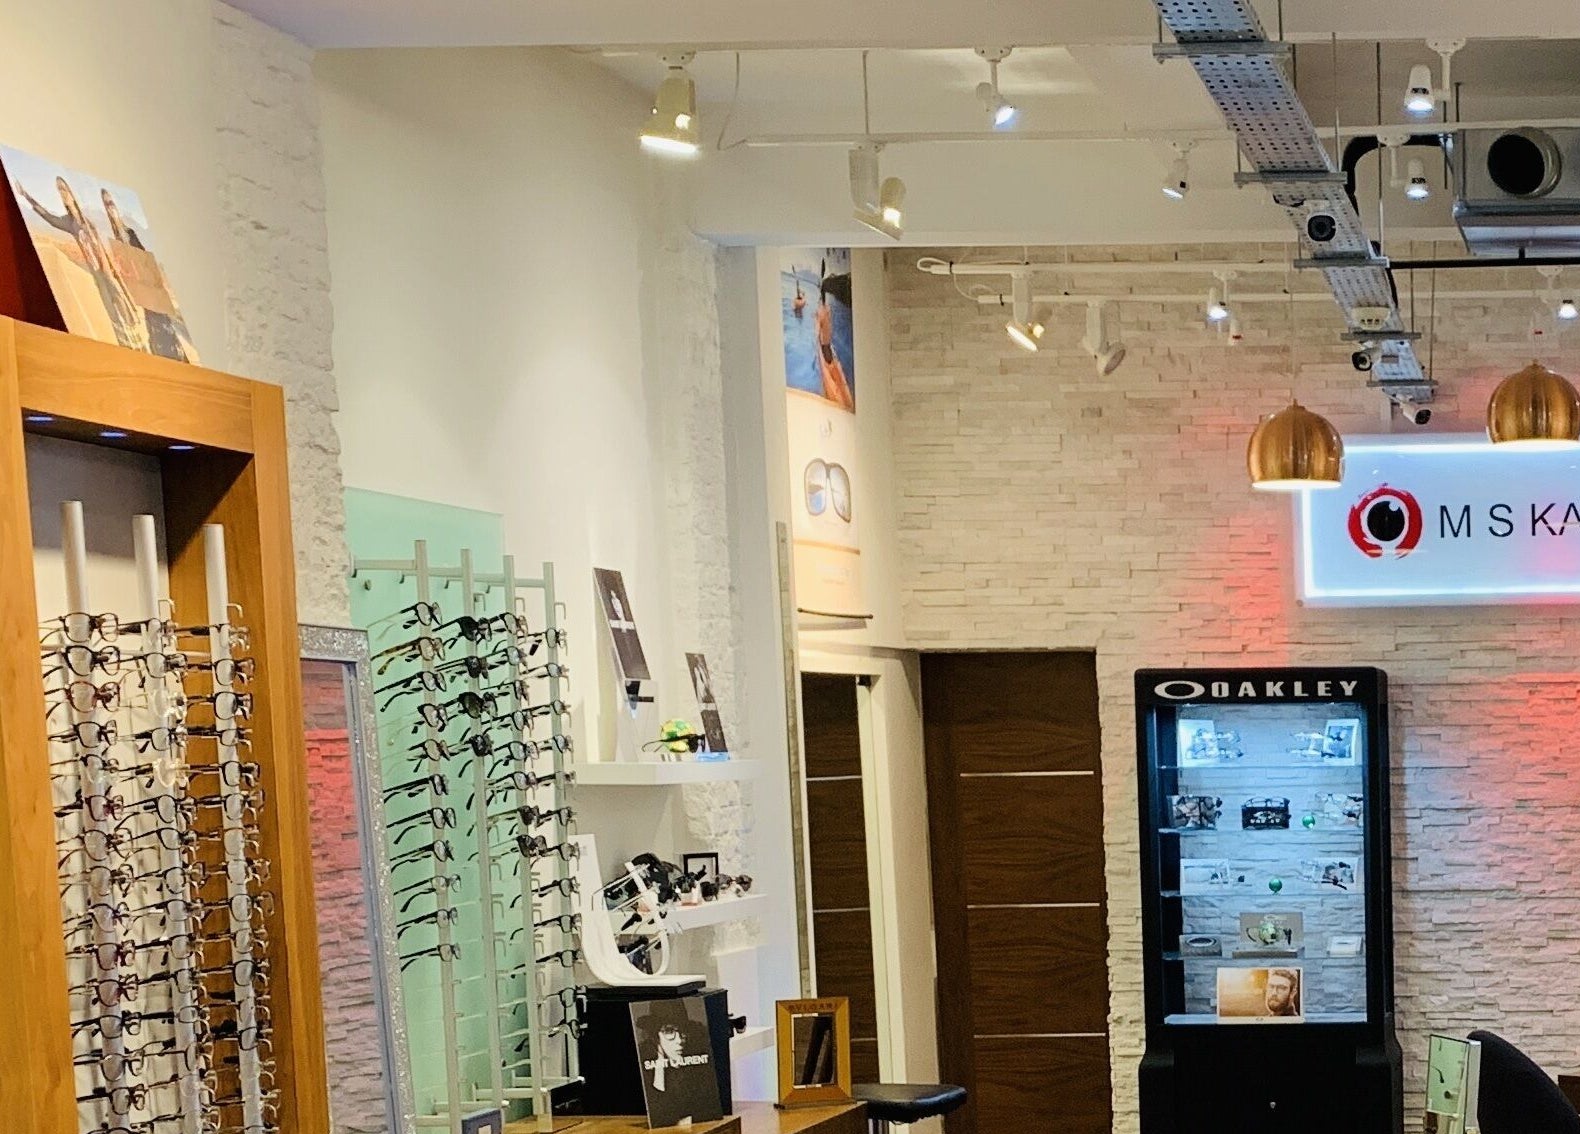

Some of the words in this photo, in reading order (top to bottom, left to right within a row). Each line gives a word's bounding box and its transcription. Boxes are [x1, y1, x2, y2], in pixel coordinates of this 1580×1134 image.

[1439, 504, 1471, 539] M
[1488, 502, 1514, 537] S
[1211, 680, 1358, 698] OAKLEY
